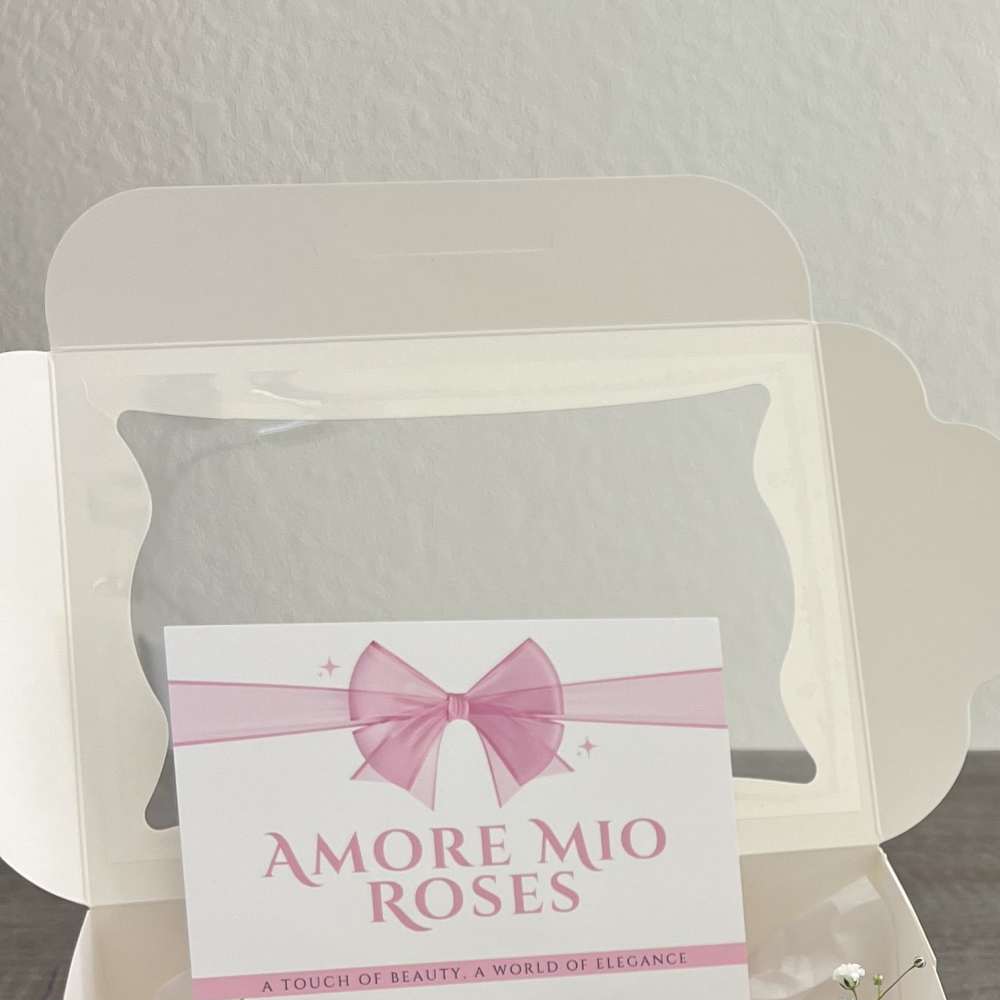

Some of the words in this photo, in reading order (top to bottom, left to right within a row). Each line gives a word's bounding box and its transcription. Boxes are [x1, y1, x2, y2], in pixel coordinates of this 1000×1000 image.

[261, 823, 513, 889] AMORE
[529, 816, 669, 873] MIO
[366, 870, 582, 933] ROSES
[262, 981, 274, 994] A
[280, 974, 350, 992] TOUCH
[358, 972, 382, 987] OF
[391, 967, 467, 984] BEAUTY,
[474, 966, 485, 979] A
[492, 960, 560, 977] WORLD
[566, 958, 589, 972] OF
[596, 952, 688, 971] ELEGANCE
